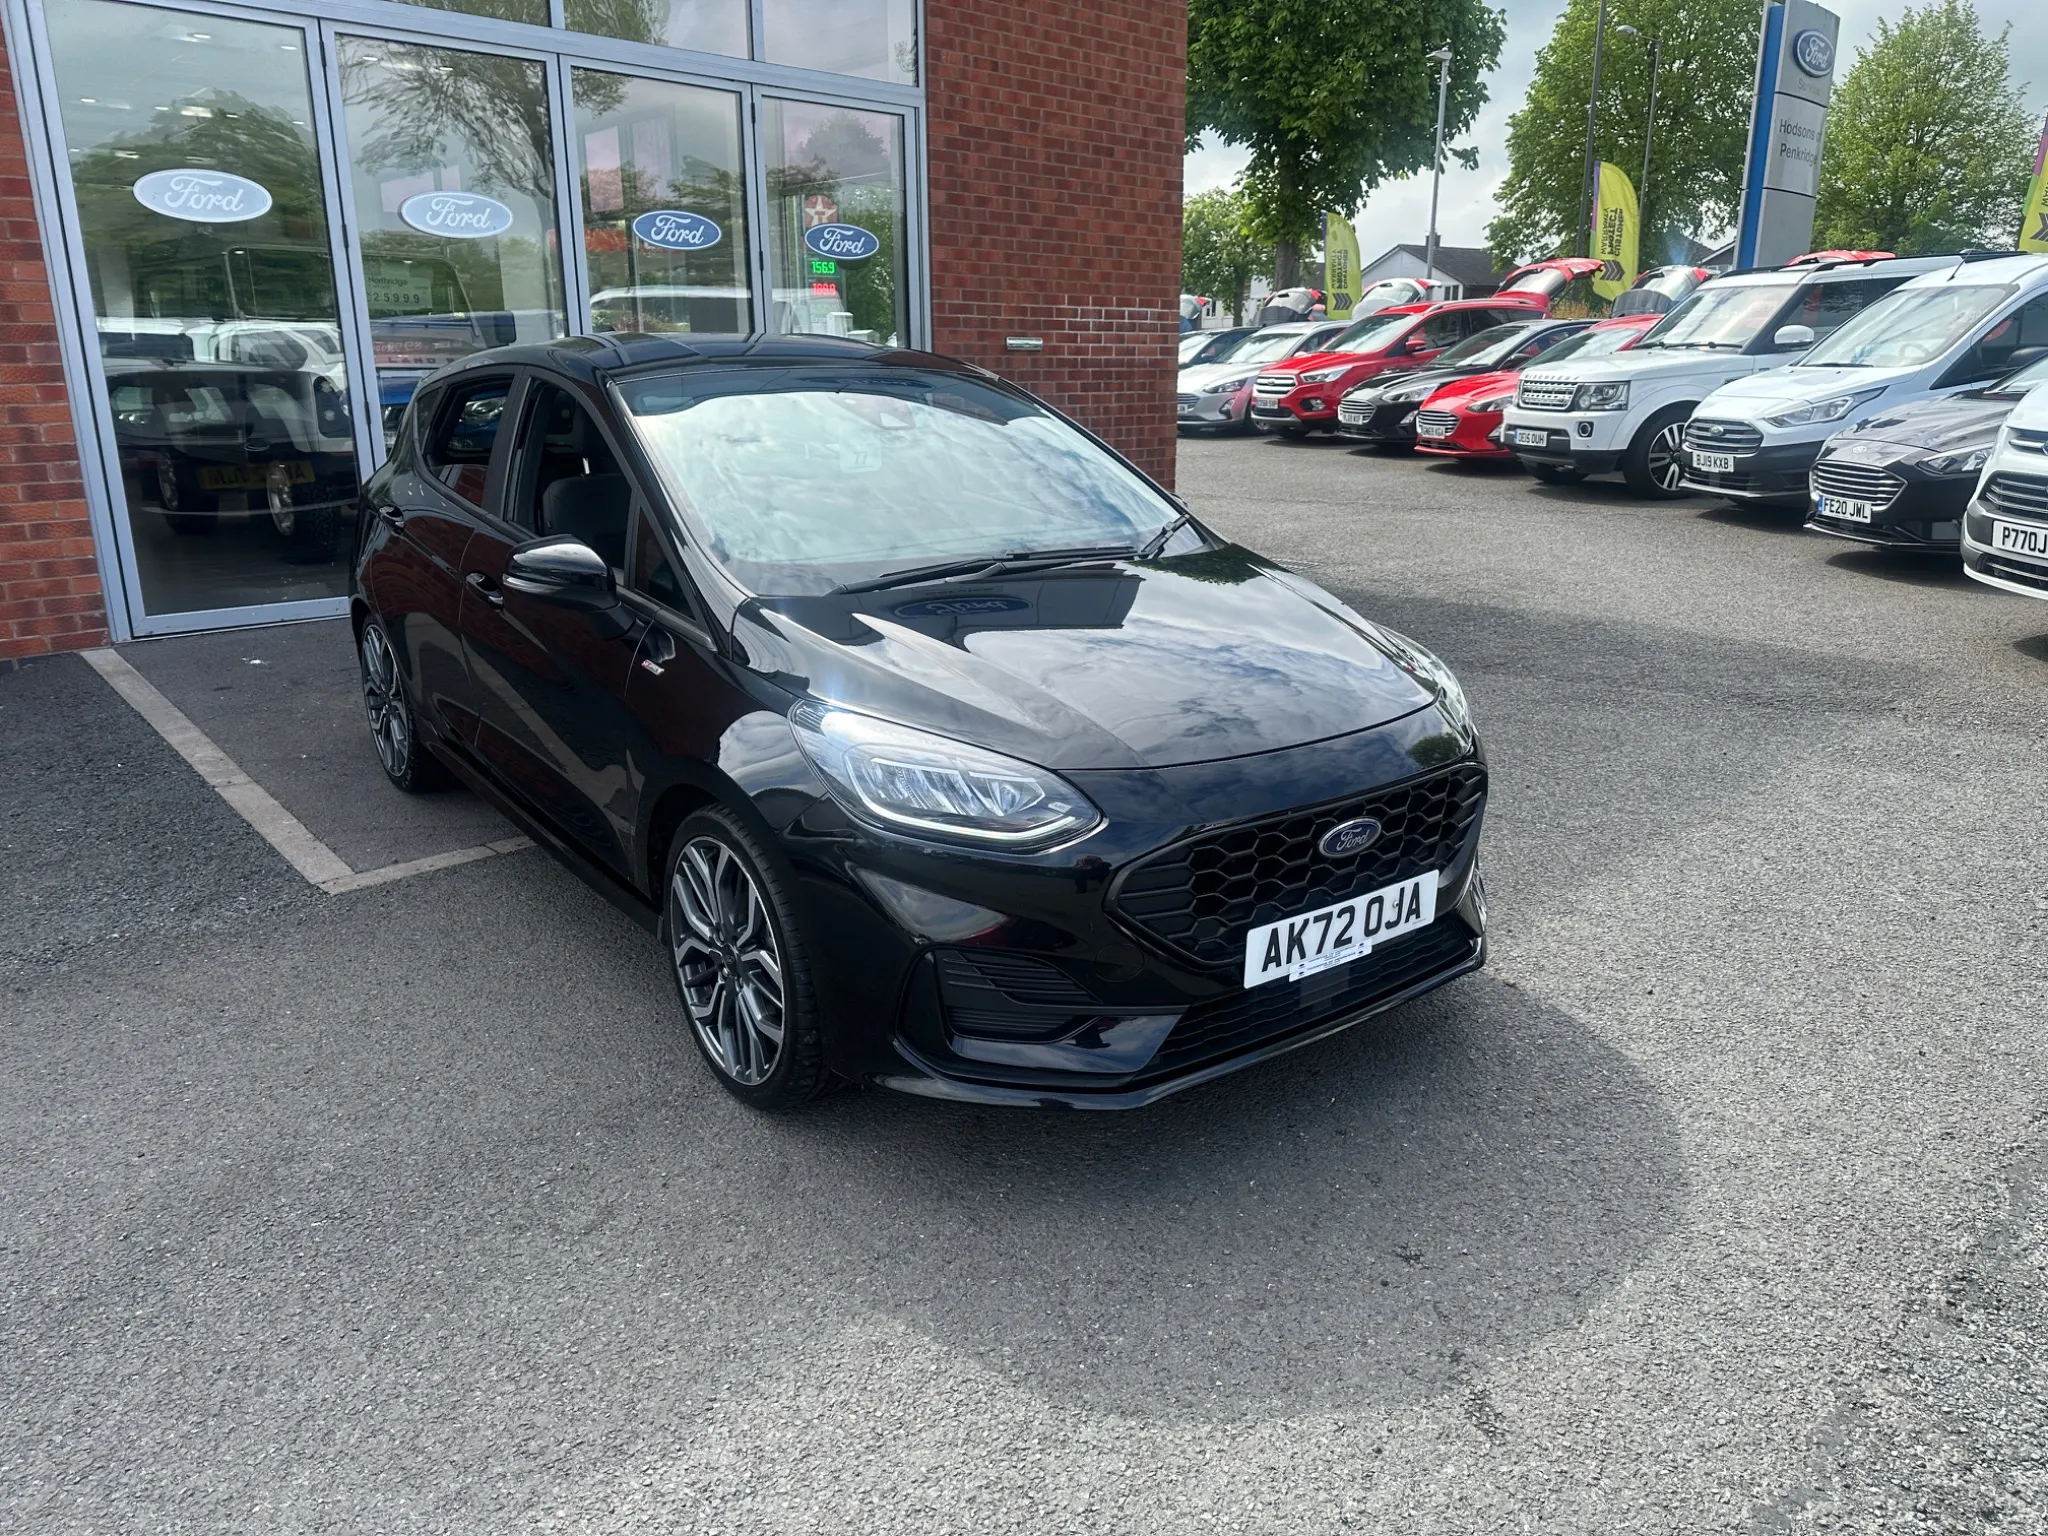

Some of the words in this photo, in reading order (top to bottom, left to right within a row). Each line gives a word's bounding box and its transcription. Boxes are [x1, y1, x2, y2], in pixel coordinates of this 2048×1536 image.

[1805, 36, 1829, 68] Ford
[1779, 118, 1816, 141] Hodsons
[1779, 143, 1819, 167] Penkridge
[164, 175, 244, 213] Ford
[426, 197, 491, 229] Ford
[650, 214, 705, 245] Ford
[819, 227, 865, 256] Ford
[1696, 453, 1712, 468] BJ19
[1713, 456, 1729, 469] KXB
[1823, 497, 1848, 515] FE20
[1849, 502, 1869, 519] JWL
[1336, 827, 1371, 851] Ford
[1261, 904, 1356, 973] AK72
[1364, 882, 1421, 938] OJA
